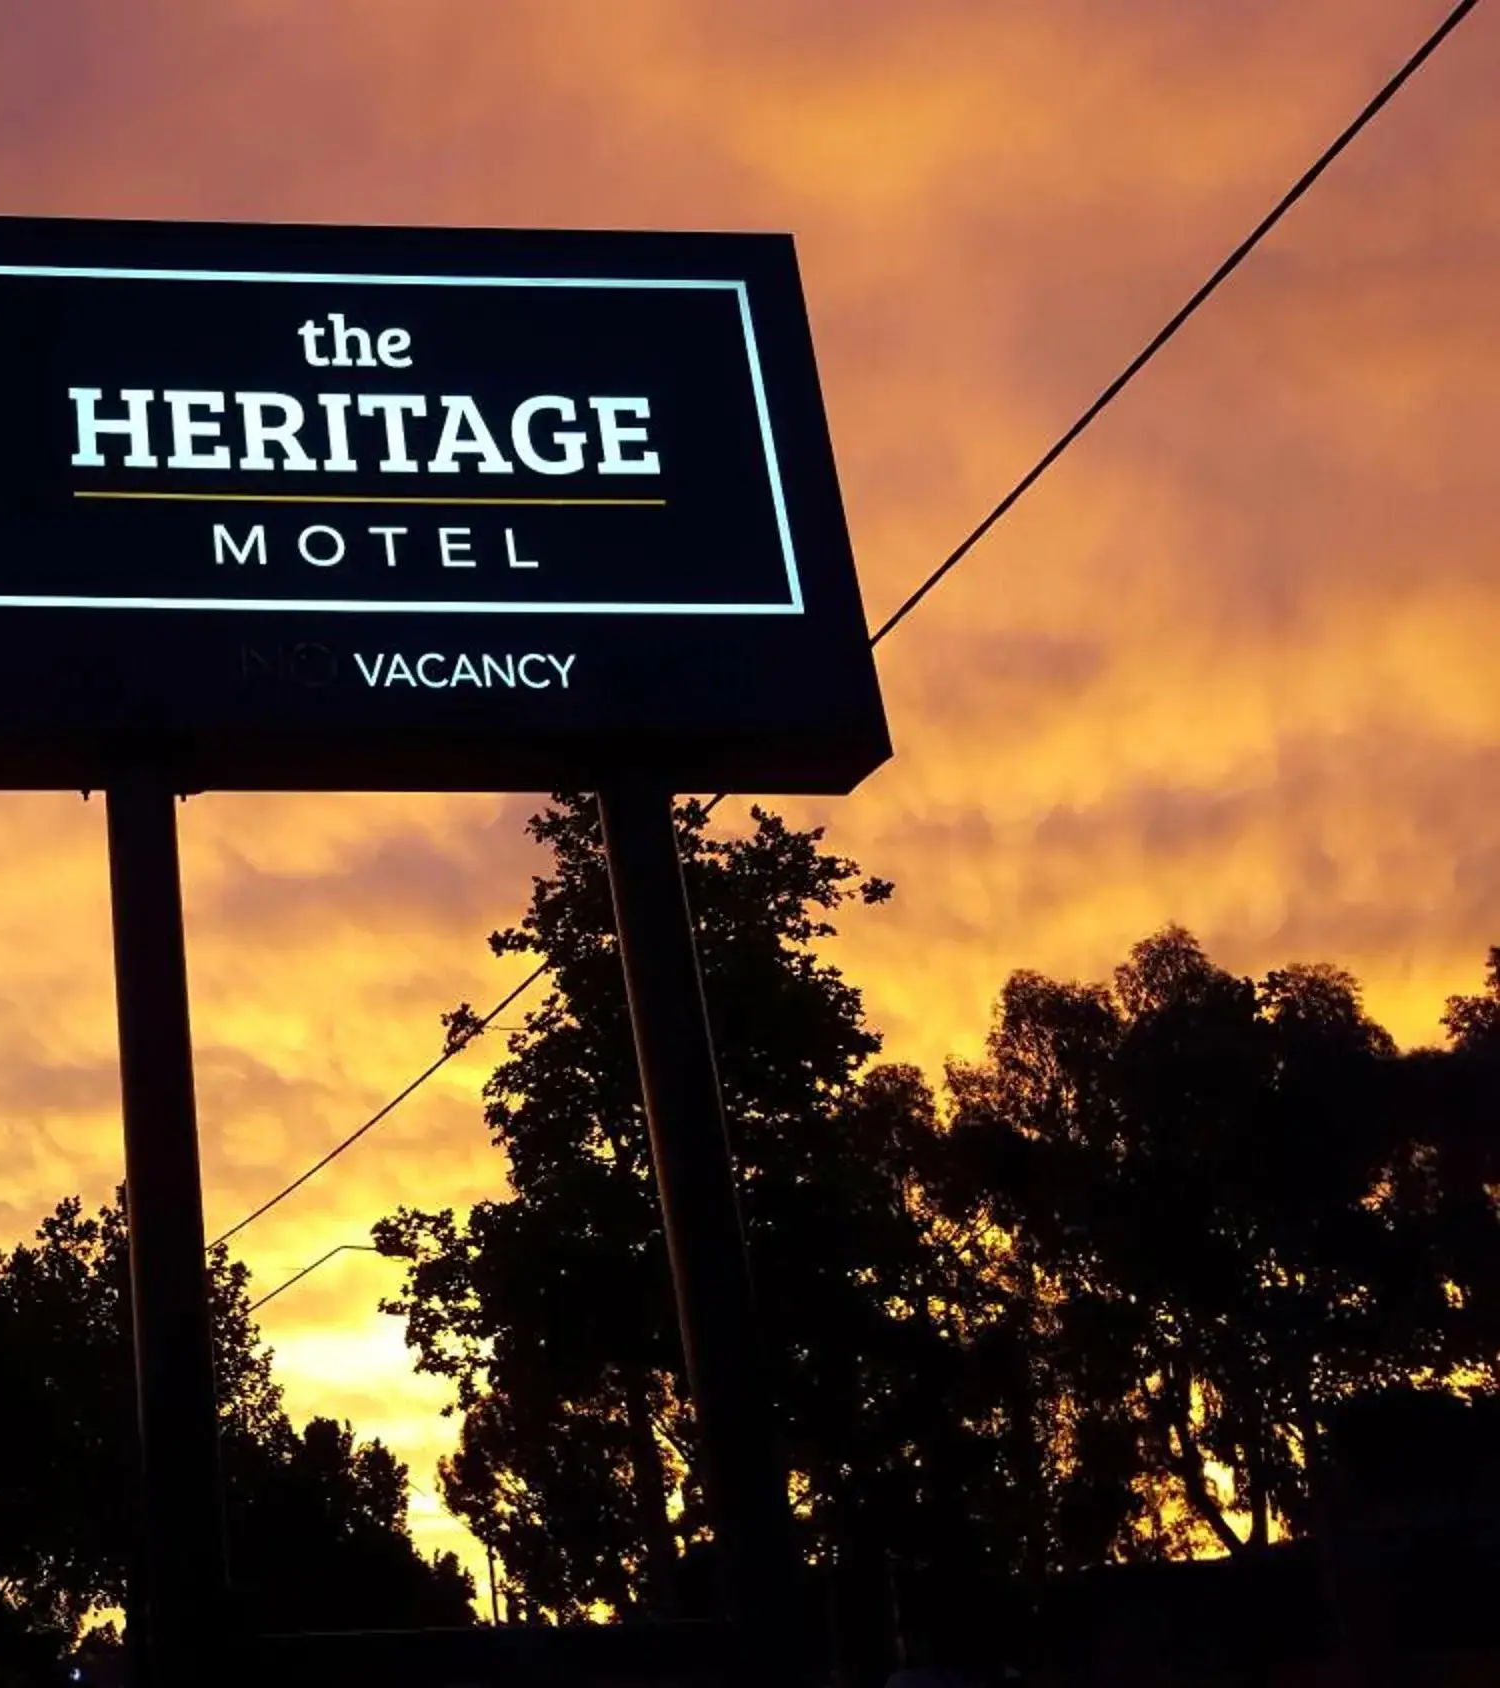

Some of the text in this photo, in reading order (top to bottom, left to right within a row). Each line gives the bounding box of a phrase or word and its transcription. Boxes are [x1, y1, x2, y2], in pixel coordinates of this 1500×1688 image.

[298, 312, 413, 369] the
[67, 387, 661, 476] HERITAGE
[213, 523, 539, 569] MOTEL
[241, 641, 576, 689] NO VACANCY
